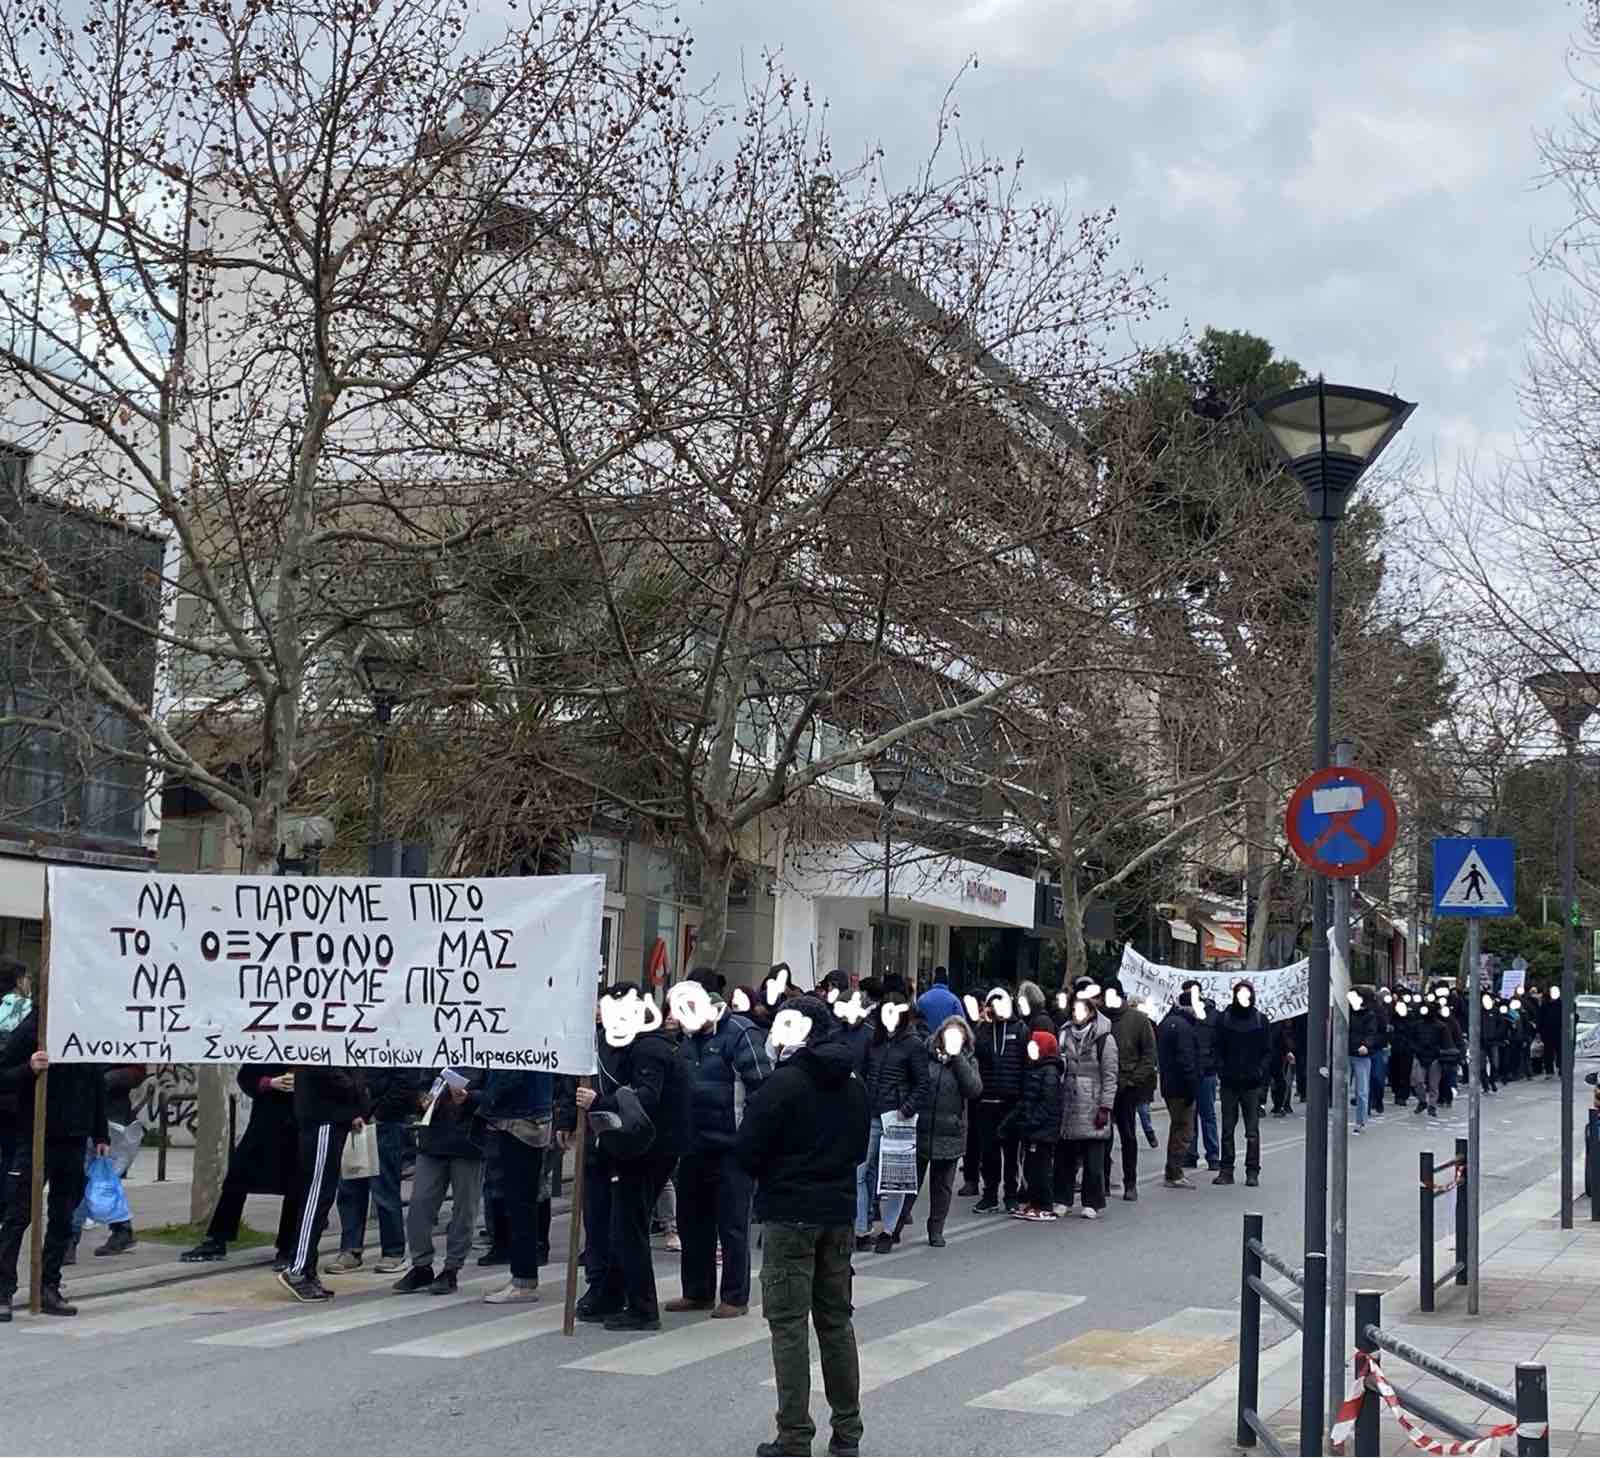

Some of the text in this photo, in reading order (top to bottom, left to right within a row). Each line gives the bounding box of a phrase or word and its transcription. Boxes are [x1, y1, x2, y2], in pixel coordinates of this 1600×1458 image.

[137, 882, 484, 931] ΝΑ ΠΑΡΟΥΜΕ ΠΙΣΩ
[110, 927, 517, 970] ΤΟ ΟΞΥΓΟΝΟ ΜΑΣ
[132, 962, 482, 1006] ΝΑ ΠΑΡΟΥΜΕ ΠΙΣΩ
[125, 1000, 509, 1034] ΤΙΣ ΖΩΕΣ ΜΑΣ
[61, 1031, 172, 1062] Ανοιχτή
[203, 1033, 333, 1066] Συνέλευση
